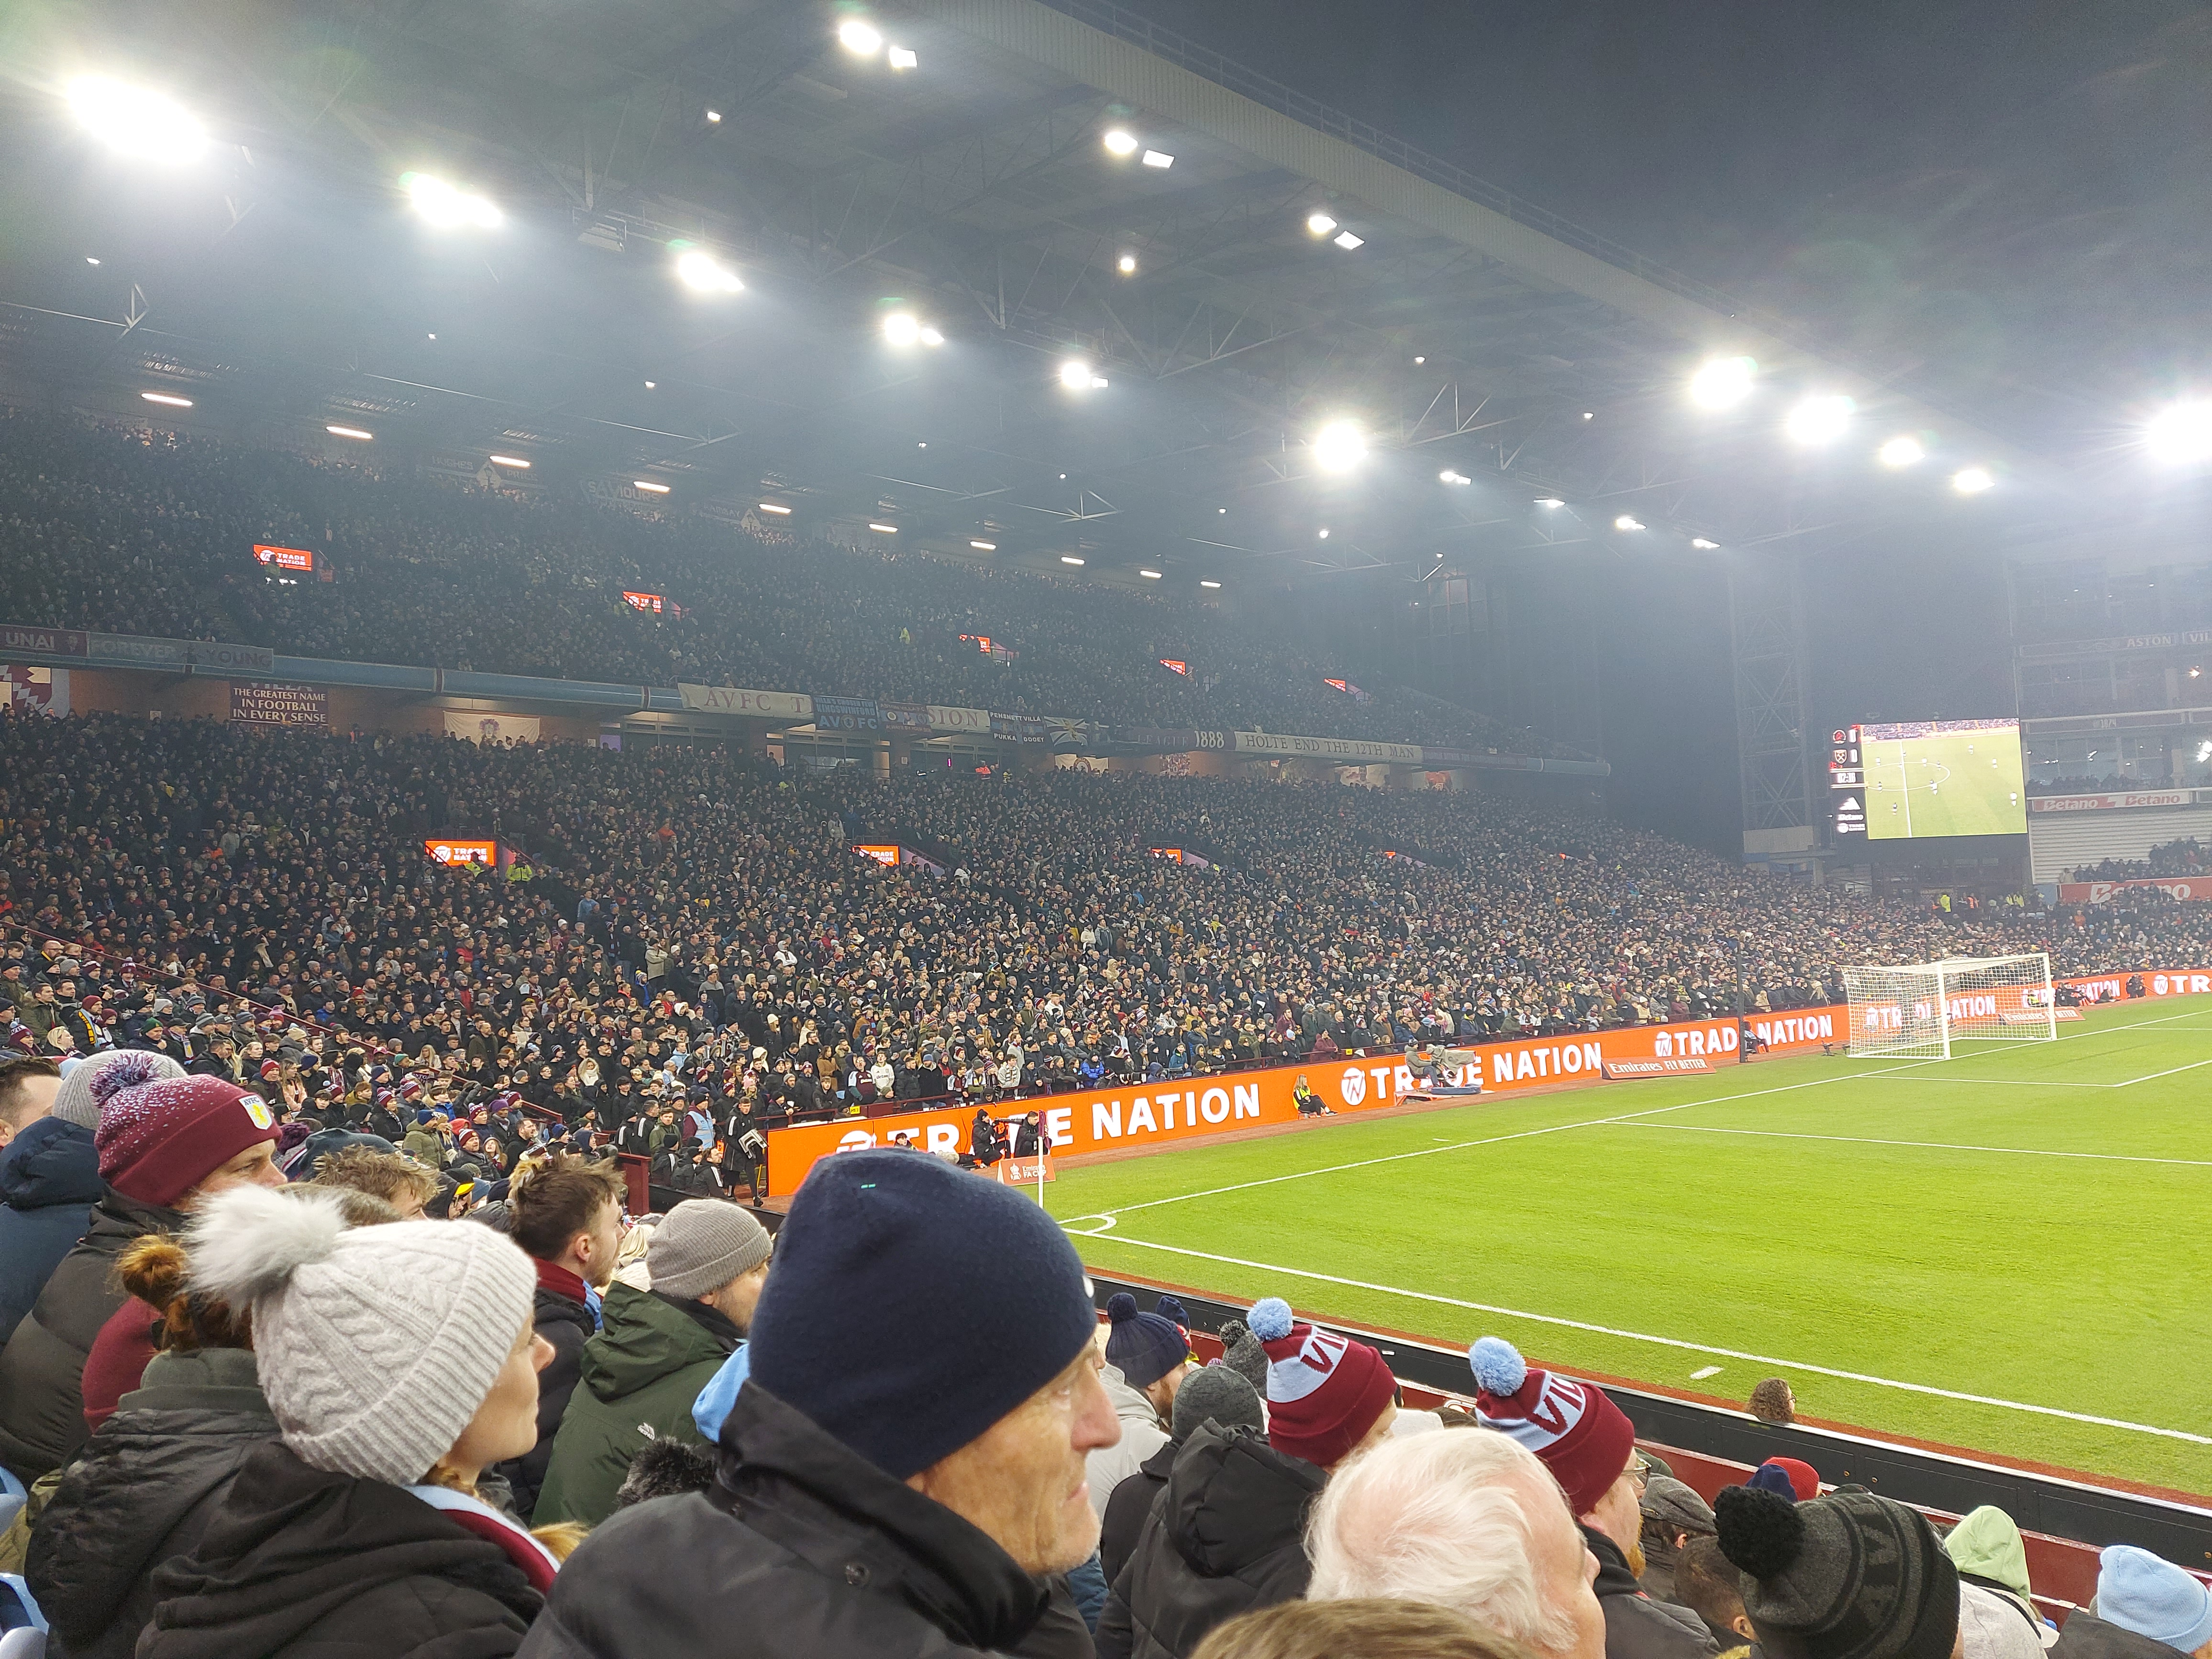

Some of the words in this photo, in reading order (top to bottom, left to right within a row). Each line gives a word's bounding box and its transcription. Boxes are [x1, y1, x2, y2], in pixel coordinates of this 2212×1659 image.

[276, 553, 306, 561] TRADE
[5, 632, 55, 648] UNAI
[2127, 636, 2171, 647] ASTON
[206, 647, 272, 666] YOUNG
[233, 687, 251, 697] THE
[253, 689, 298, 700] GREATEST
[299, 693, 326, 701] NAME
[704, 690, 771, 711] AVFC
[242, 698, 254, 708] IN
[258, 700, 318, 712] FOOTBALL
[816, 704, 876, 716] KINGSWINFORD
[233, 708, 247, 718] IN
[250, 710, 288, 721] EVERY
[290, 713, 326, 722] SENSE
[990, 712, 1022, 721] PENSNETT
[994, 733, 1017, 741] PUKKA
[1194, 730, 1225, 749] 1888
[1245, 735, 1288, 749] HOLTE
[1294, 738, 1320, 752] END
[1324, 741, 1350, 753] THE
[1355, 743, 1383, 756] 12TH
[1389, 745, 1415, 758] MAN
[2043, 799, 2099, 810] Betano
[2125, 795, 2180, 806] Betano
[1674, 1026, 1739, 1056] TRAD
[1757, 1014, 1834, 1047] NATION
[1492, 1041, 1603, 1084] NATION
[1609, 1062, 1664, 1074] Emirates
[1664, 1060, 1678, 1071] FLY
[1680, 1058, 1708, 1069] BETTER
[243, 1097, 260, 1106] AVFC
[1092, 1083, 1261, 1141] NATION
